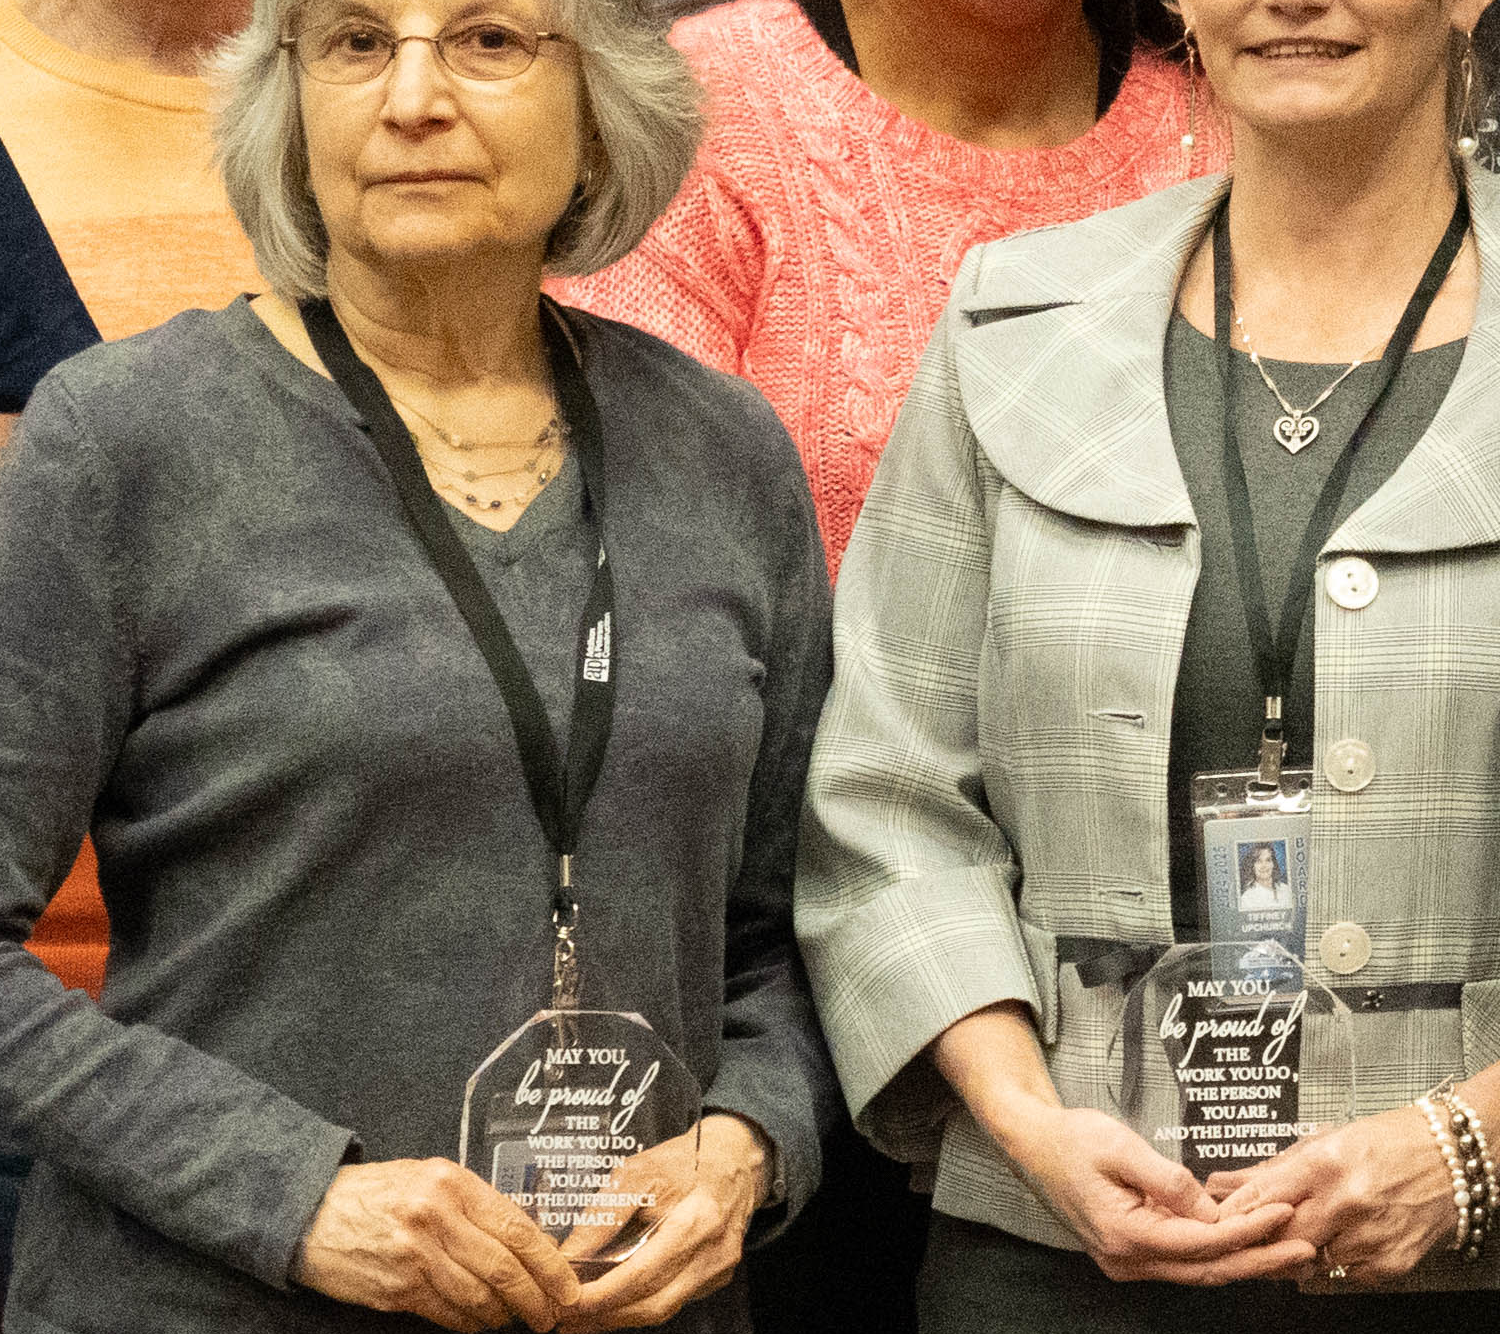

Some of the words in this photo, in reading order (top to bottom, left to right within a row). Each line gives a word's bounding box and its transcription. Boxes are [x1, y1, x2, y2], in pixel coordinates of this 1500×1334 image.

[1187, 981, 1226, 998] MAY
[1231, 980, 1271, 995] YOU
[1159, 993, 1187, 1039] be
[1179, 990, 1276, 1068] proud
[1262, 990, 1308, 1066] of
[546, 1048, 585, 1065] MAY
[587, 1047, 627, 1065] YOU
[1213, 1047, 1250, 1062] THE
[1176, 1068, 1226, 1082] WORK
[1228, 1067, 1264, 1081] YOU
[515, 1059, 541, 1105] be
[531, 1059, 630, 1134] proud
[611, 1060, 660, 1135] of
[1186, 1087, 1220, 1101] THE
[1220, 1085, 1281, 1100] PERSON
[1201, 1106, 1237, 1120] YOU
[565, 1116, 599, 1131] THE
[1154, 1127, 1189, 1140] AND
[1190, 1125, 1223, 1139] THE
[1224, 1123, 1318, 1139] DIFFERENCE
[527, 1136, 577, 1150] WORK
[578, 1135, 613, 1150] YOU
[1196, 1143, 1232, 1158] YOU
[535, 1155, 566, 1168] THE
[566, 1154, 625, 1168] PERSON
[547, 1174, 583, 1188] YOU
[508, 1193, 533, 1207] ND
[536, 1193, 565, 1207] THE
[567, 1193, 656, 1207] DIFFERENCE
[540, 1212, 572, 1226] YOU
